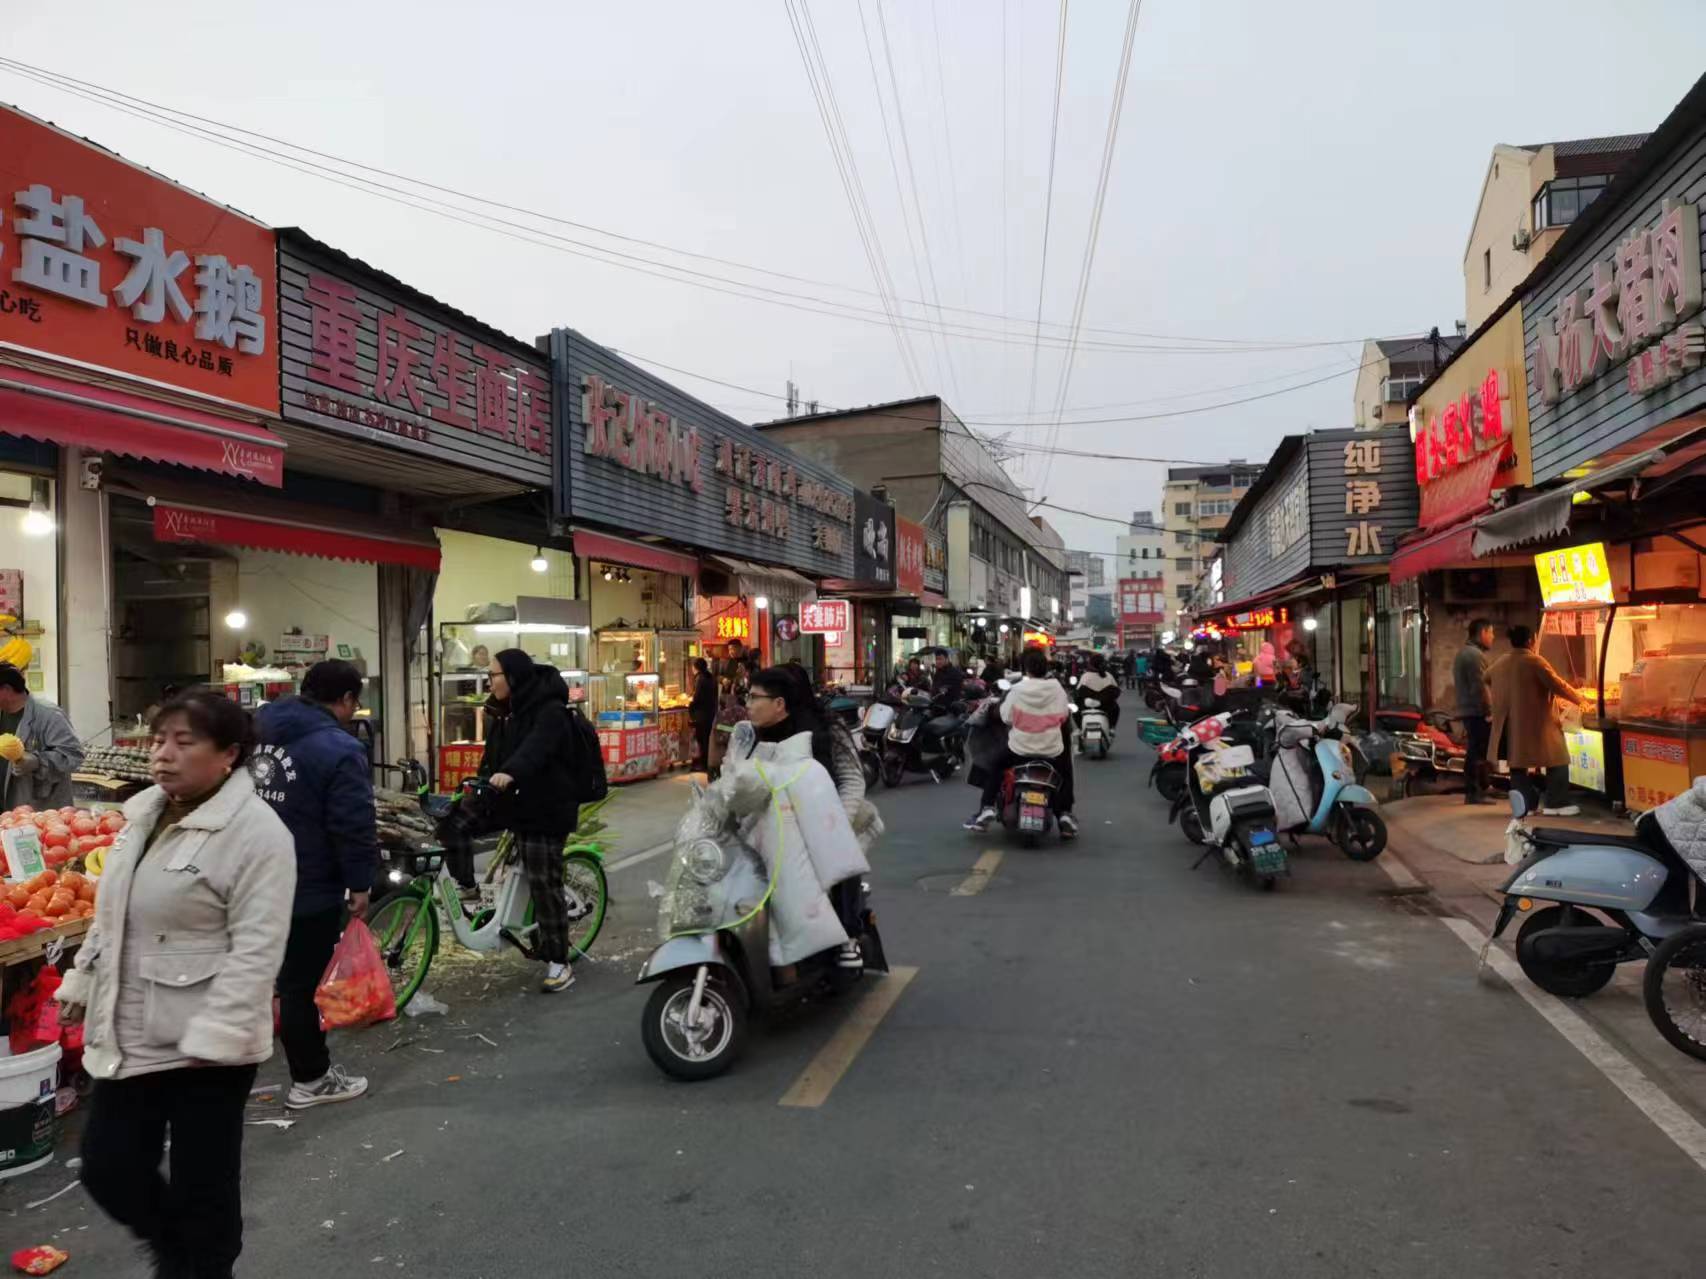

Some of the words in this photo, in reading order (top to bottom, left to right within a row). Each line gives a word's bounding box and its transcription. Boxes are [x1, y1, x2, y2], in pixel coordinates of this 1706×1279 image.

[0, 184, 265, 356] 盐水鹅
[123, 327, 234, 377] 只做良心品质
[1343, 439, 1382, 556] 纯净水
